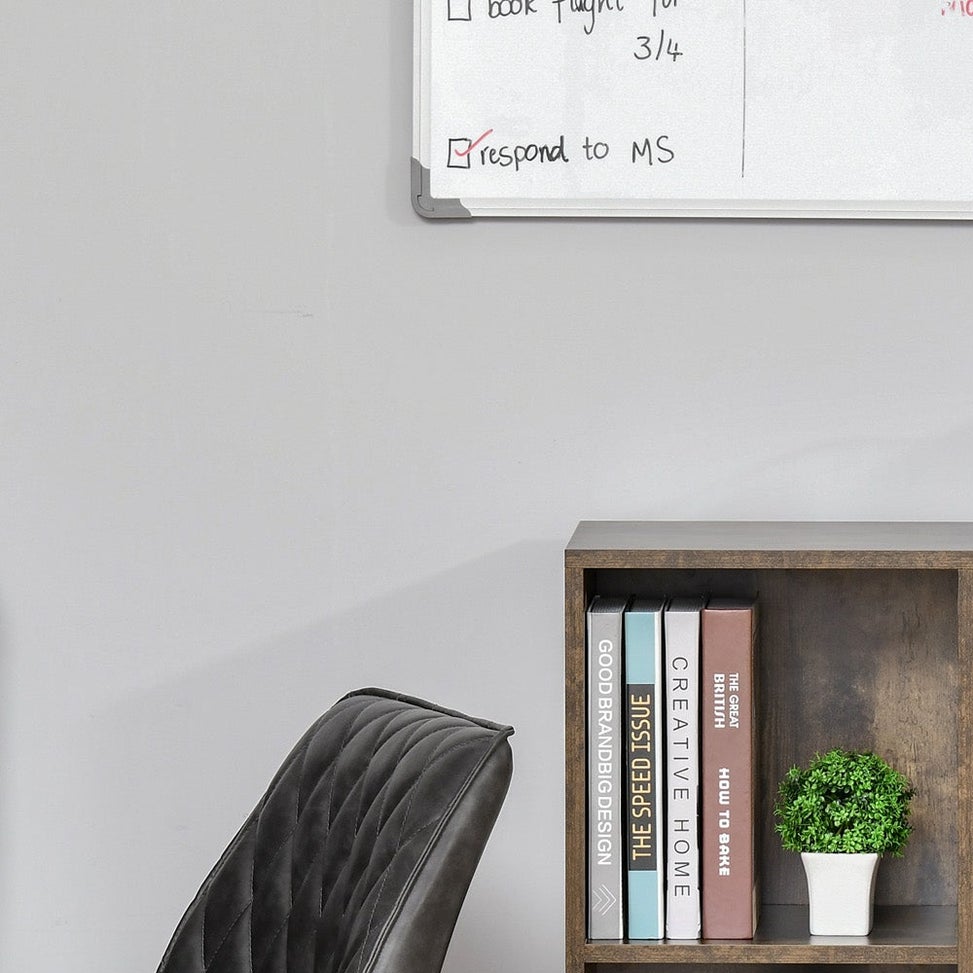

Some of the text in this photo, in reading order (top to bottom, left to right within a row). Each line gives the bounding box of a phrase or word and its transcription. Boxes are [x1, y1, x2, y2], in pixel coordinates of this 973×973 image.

[633, 29, 684, 62] 3/4
[480, 135, 674, 171] respond to MS
[714, 673, 726, 729] BRITISH
[729, 673, 740, 729] THE GREAT
[631, 694, 652, 861] THE SPEED ISSUE
[672, 656, 690, 897] CREATIVE HOME
[718, 767, 731, 876] HOW TO BAKE
